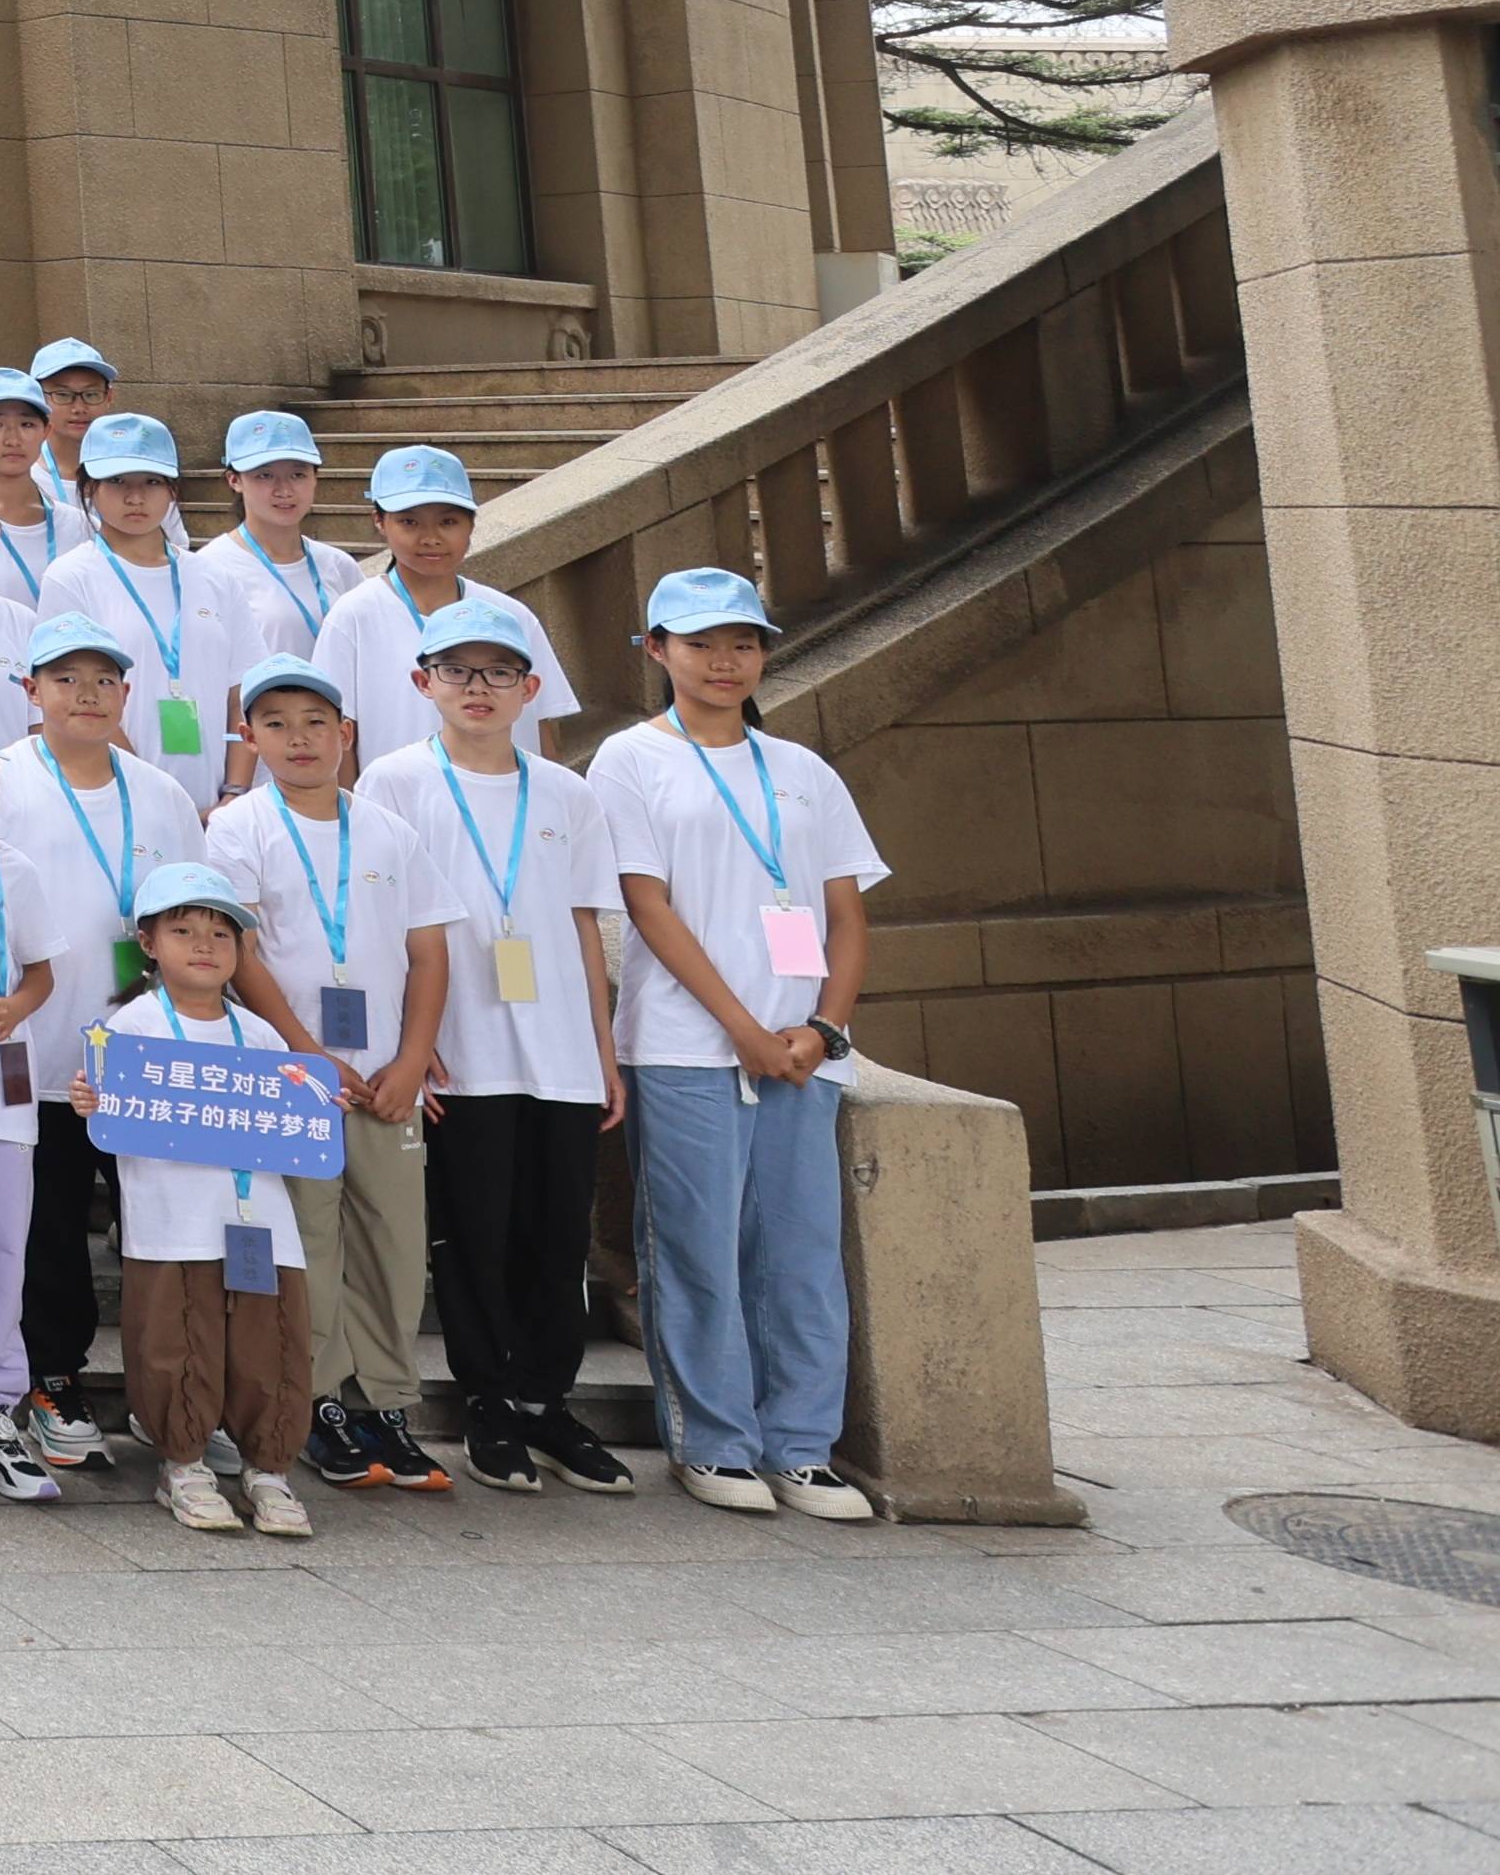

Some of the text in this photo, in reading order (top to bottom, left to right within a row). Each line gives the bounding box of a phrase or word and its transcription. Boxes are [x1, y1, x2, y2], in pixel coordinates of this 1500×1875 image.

[141, 1061, 281, 1099] 与星空对话
[98, 1093, 332, 1141] 助力孩子的科学梦想
